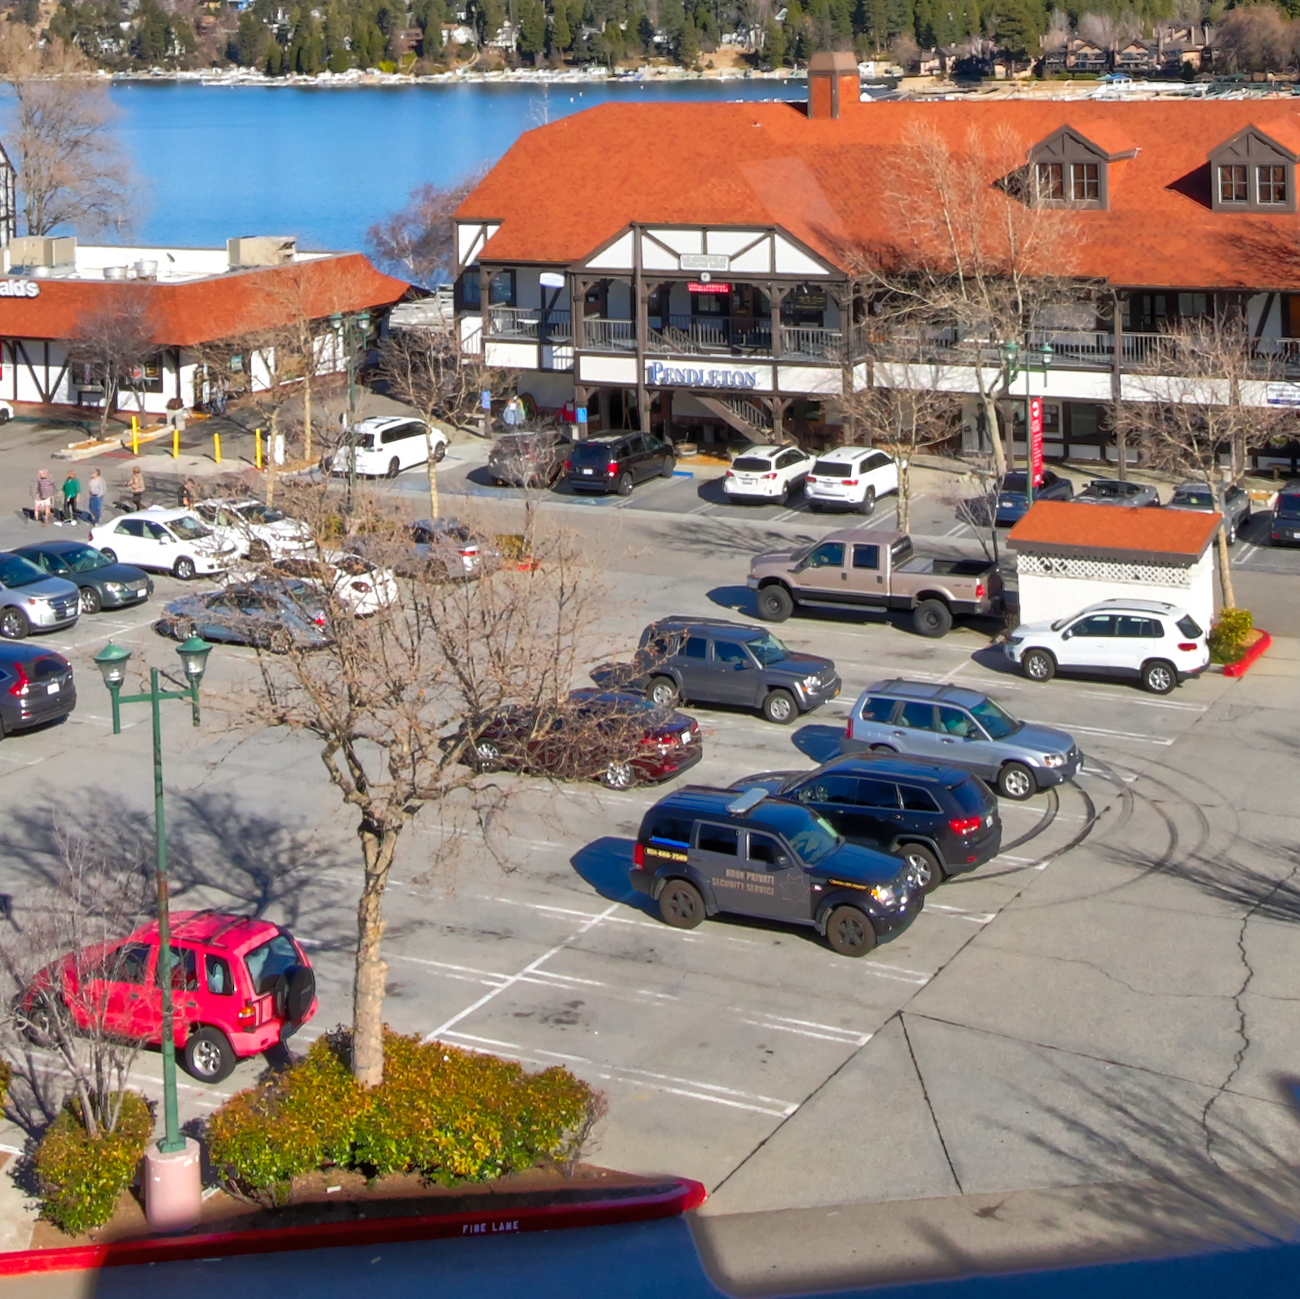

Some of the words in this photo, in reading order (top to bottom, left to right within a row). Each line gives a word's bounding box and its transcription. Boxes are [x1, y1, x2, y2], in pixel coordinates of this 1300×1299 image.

[651, 361, 758, 386] PENDLETON
[746, 872, 775, 885] PRIVATE
[712, 878, 744, 890] SECURITY
[746, 883, 775, 896] SERVICE
[463, 1223, 486, 1234] FIRE
[492, 1220, 519, 1232] LANE
